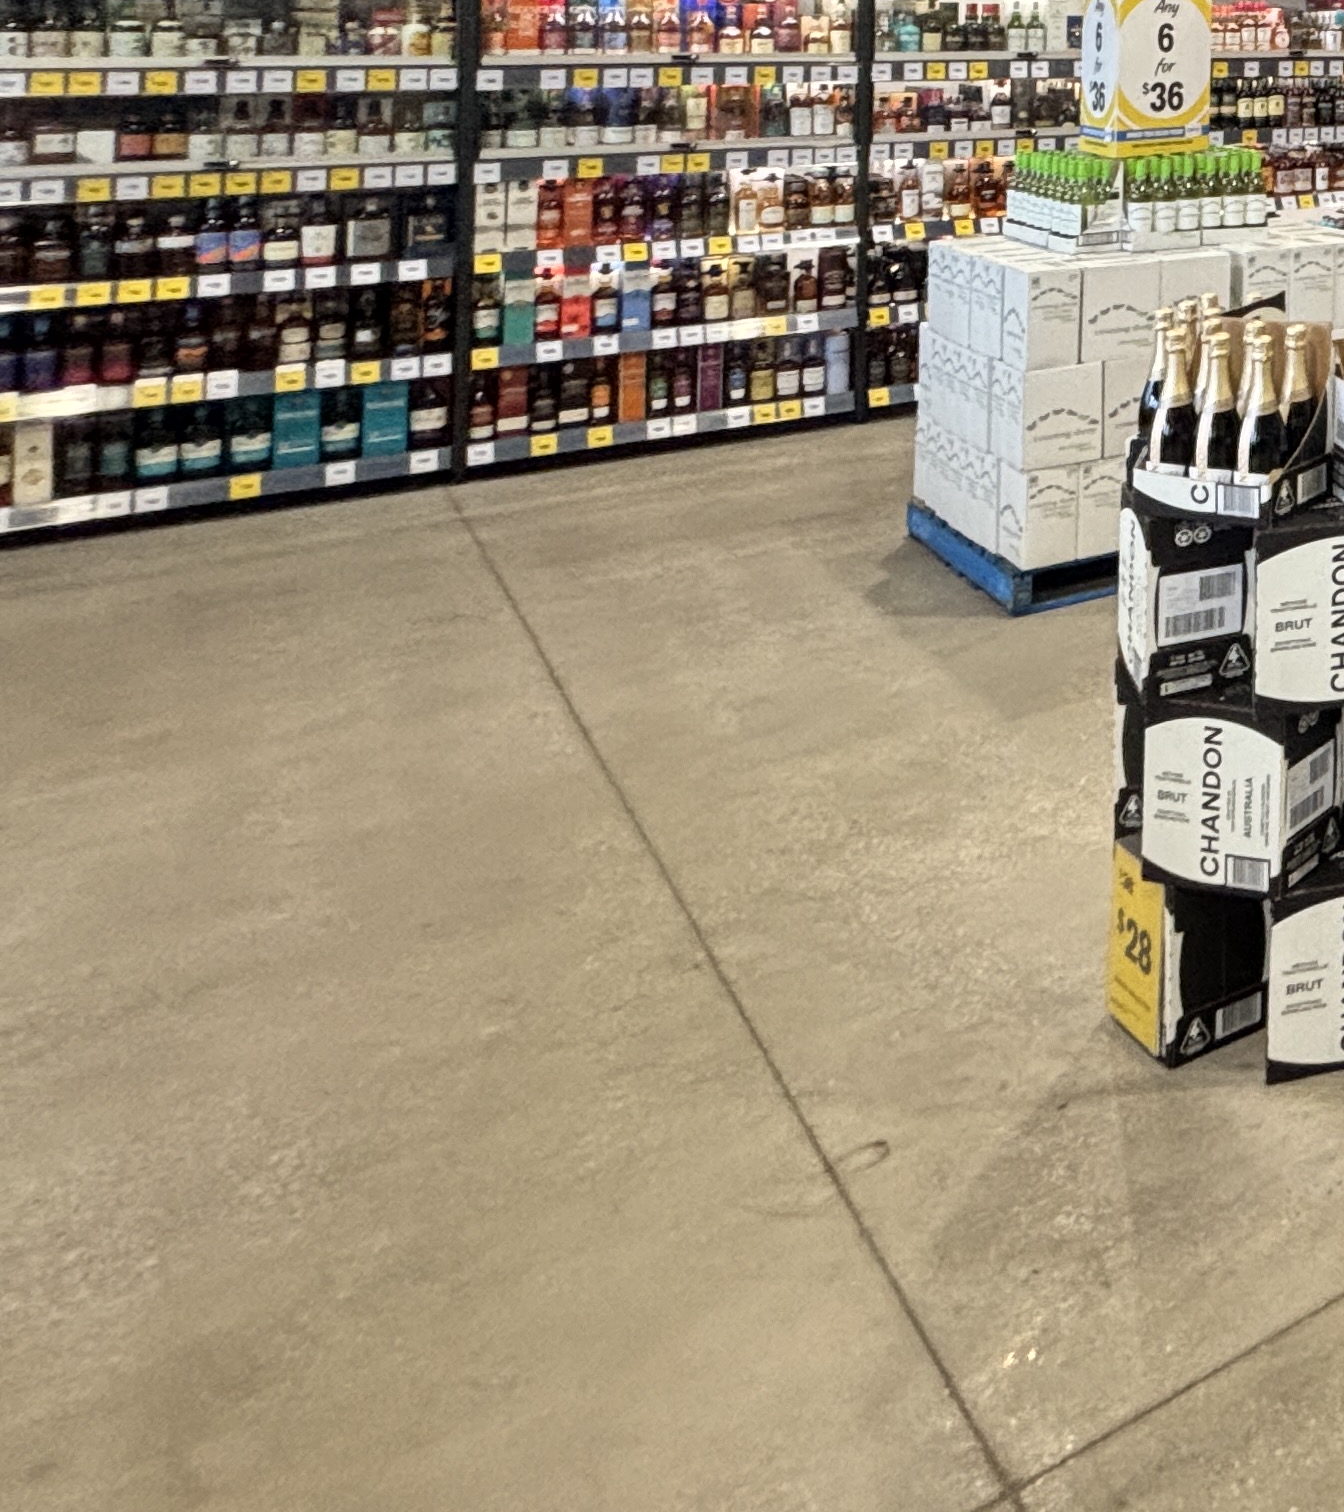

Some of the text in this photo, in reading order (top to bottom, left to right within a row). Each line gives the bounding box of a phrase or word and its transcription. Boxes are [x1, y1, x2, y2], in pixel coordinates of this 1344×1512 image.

[1157, 23, 1174, 53] 6
[1154, 58, 1176, 76] for
[1143, 81, 1184, 112] $36
[1274, 617, 1314, 633] BRUT
[1157, 789, 1190, 805] BRUT
[1201, 725, 1223, 877] CHANDON
[1117, 907, 1152, 975] $28
[1286, 977, 1324, 995] BRUT
